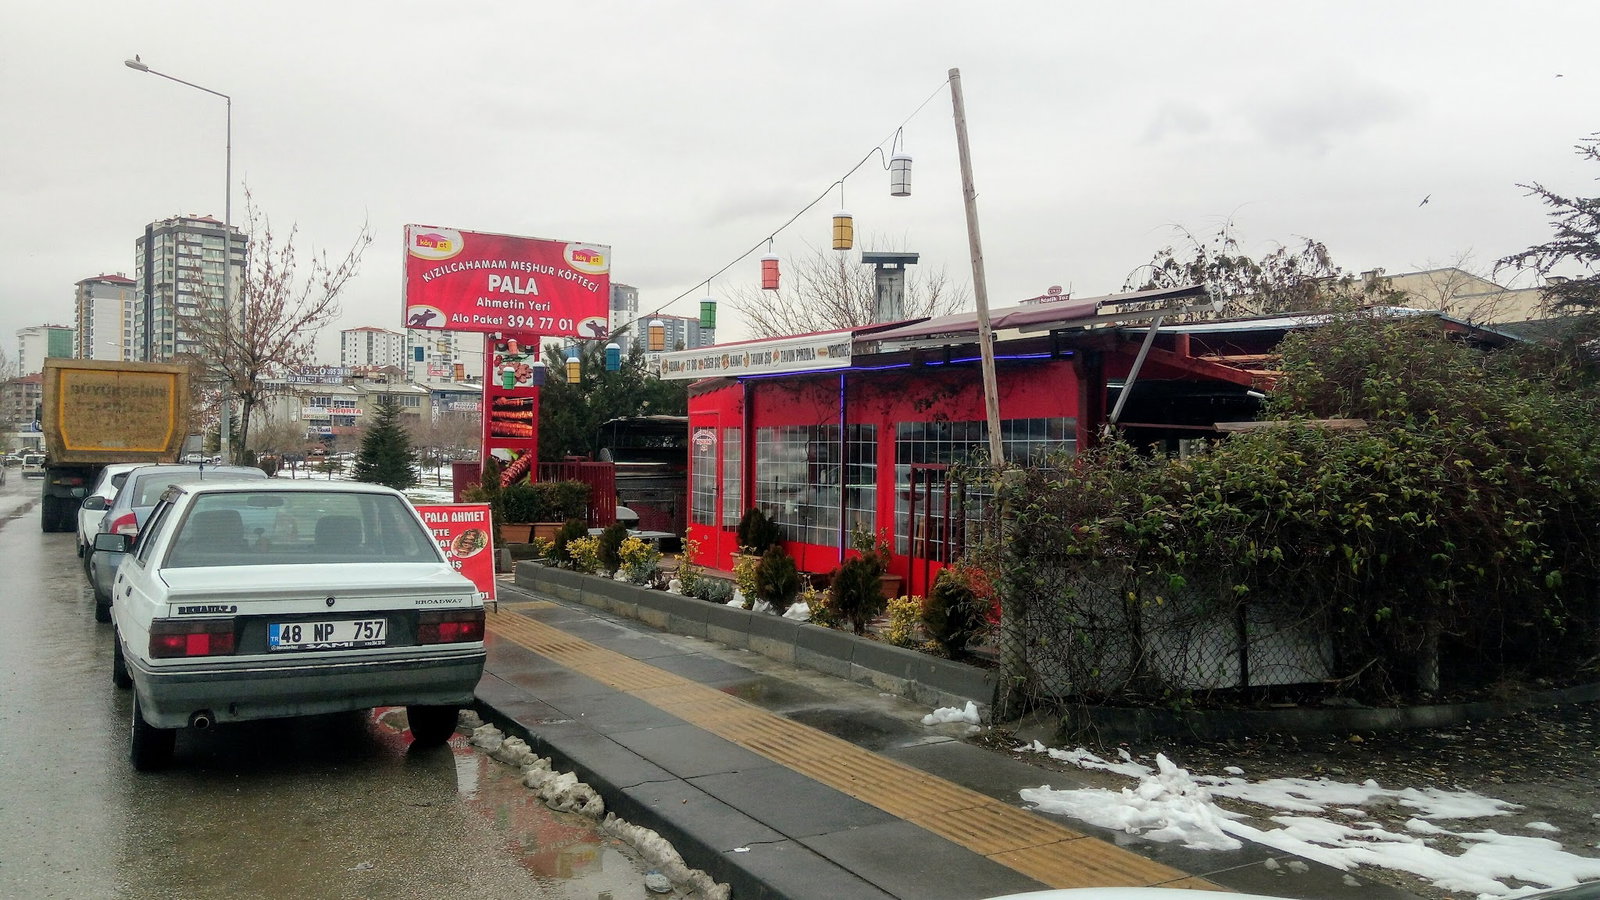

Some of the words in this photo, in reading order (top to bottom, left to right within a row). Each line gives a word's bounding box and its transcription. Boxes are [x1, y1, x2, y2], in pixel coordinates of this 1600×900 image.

[422, 260, 507, 282] KIZILCAHAMAM
[511, 260, 555, 276] MEŞHUR
[557, 269, 599, 293] KÖFTECİ
[488, 274, 539, 295] PALA
[476, 297, 525, 310] Ahmetin
[529, 300, 550, 312] Yeri
[451, 313, 469, 323] Alo
[473, 314, 503, 324] Paket
[507, 315, 534, 329] 394
[539, 317, 553, 330] 77
[558, 319, 573, 331] 01
[730, 354, 743, 367] KANAT
[751, 352, 764, 365] TAVUK
[780, 349, 795, 363] TAVUK
[795, 347, 816, 361] PİRZOLA
[424, 512, 448, 522] PALA
[451, 511, 485, 522] AHMET
[281, 625, 302, 643] 48
[313, 623, 334, 641] NP
[353, 621, 384, 640] 757
